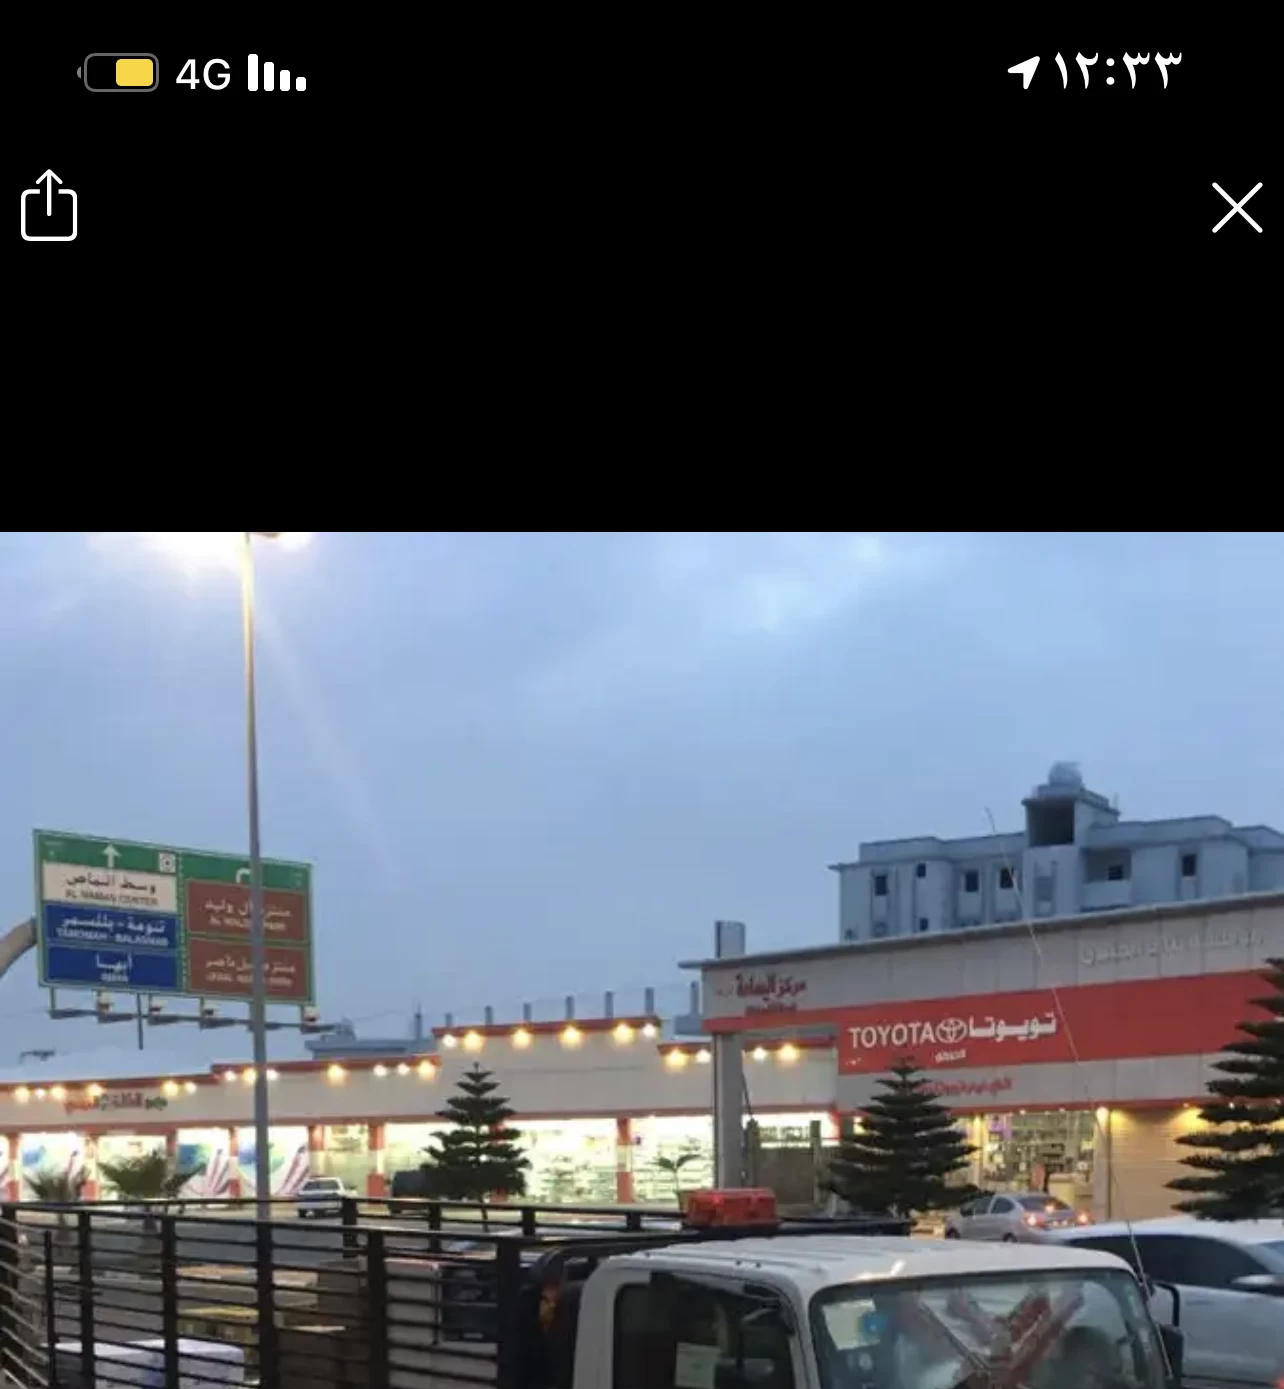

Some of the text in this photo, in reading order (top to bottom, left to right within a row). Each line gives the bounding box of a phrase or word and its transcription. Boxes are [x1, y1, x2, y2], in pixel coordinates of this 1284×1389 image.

[120, 875, 156, 895] وسط
[96, 951, 133, 974] أبها
[847, 1011, 1058, 1049] TOYOTA تويوتا
